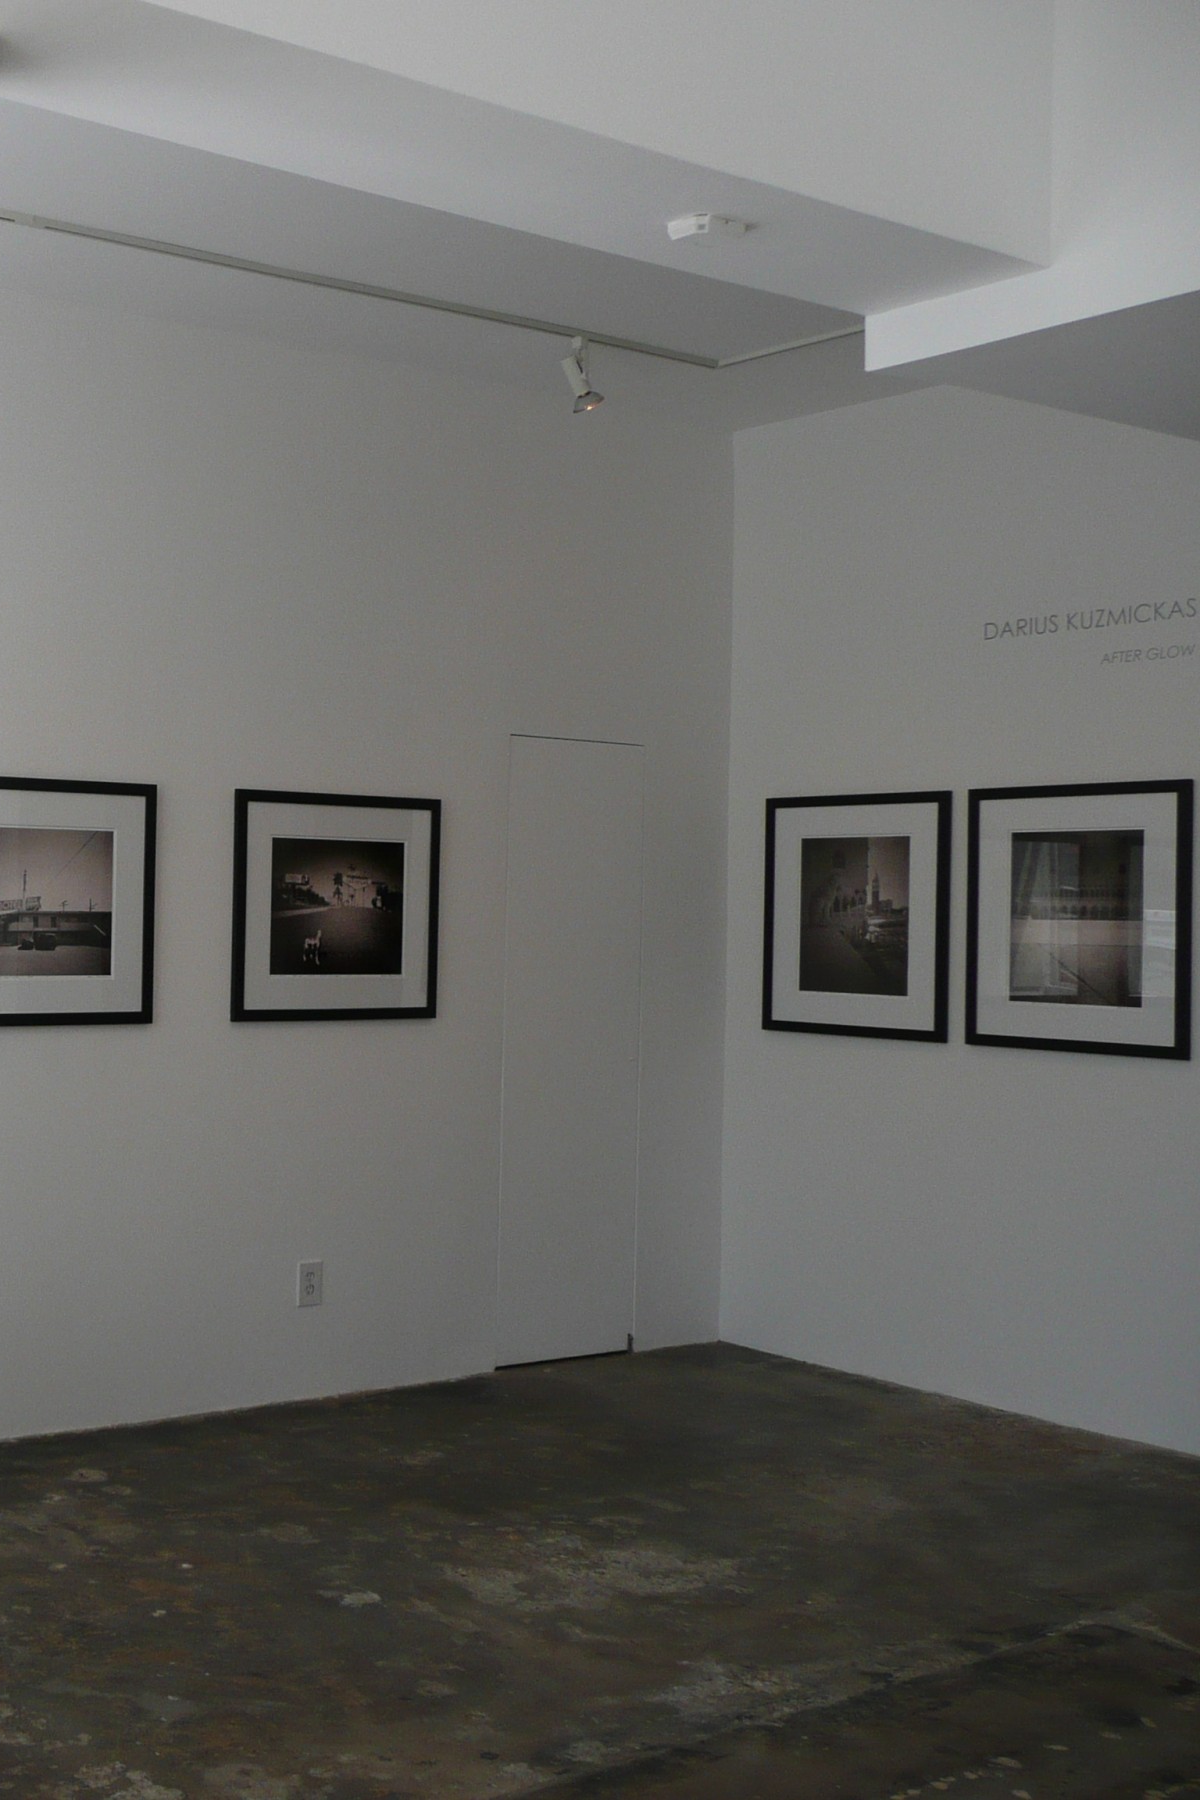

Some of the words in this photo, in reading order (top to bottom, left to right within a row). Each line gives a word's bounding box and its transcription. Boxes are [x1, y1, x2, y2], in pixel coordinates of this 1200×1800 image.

[983, 614, 1059, 641] DARIUS
[1066, 597, 1197, 631] KUZMICKAS
[1100, 649, 1142, 665] AFTER
[1146, 644, 1196, 661] GLOW
